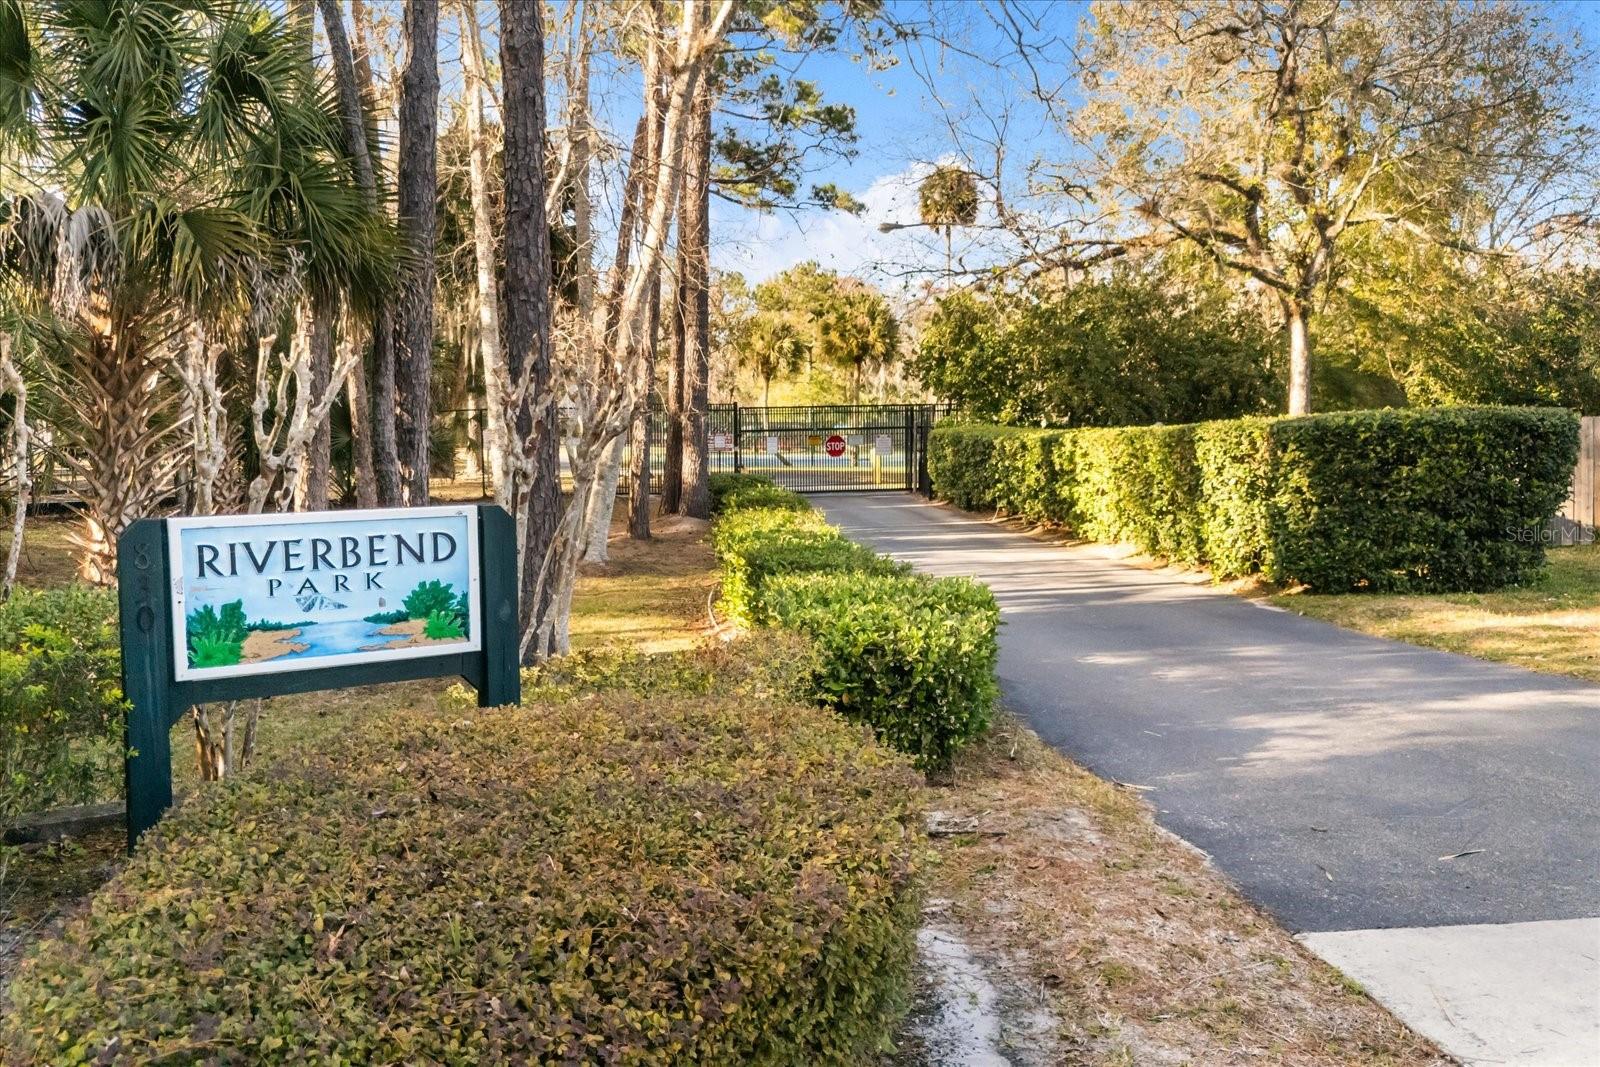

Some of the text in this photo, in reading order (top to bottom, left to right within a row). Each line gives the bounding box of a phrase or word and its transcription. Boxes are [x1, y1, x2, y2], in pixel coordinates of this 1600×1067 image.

[826, 442, 845, 451] STOP
[195, 531, 458, 579] RIVERBEND
[267, 571, 385, 598] PARK
